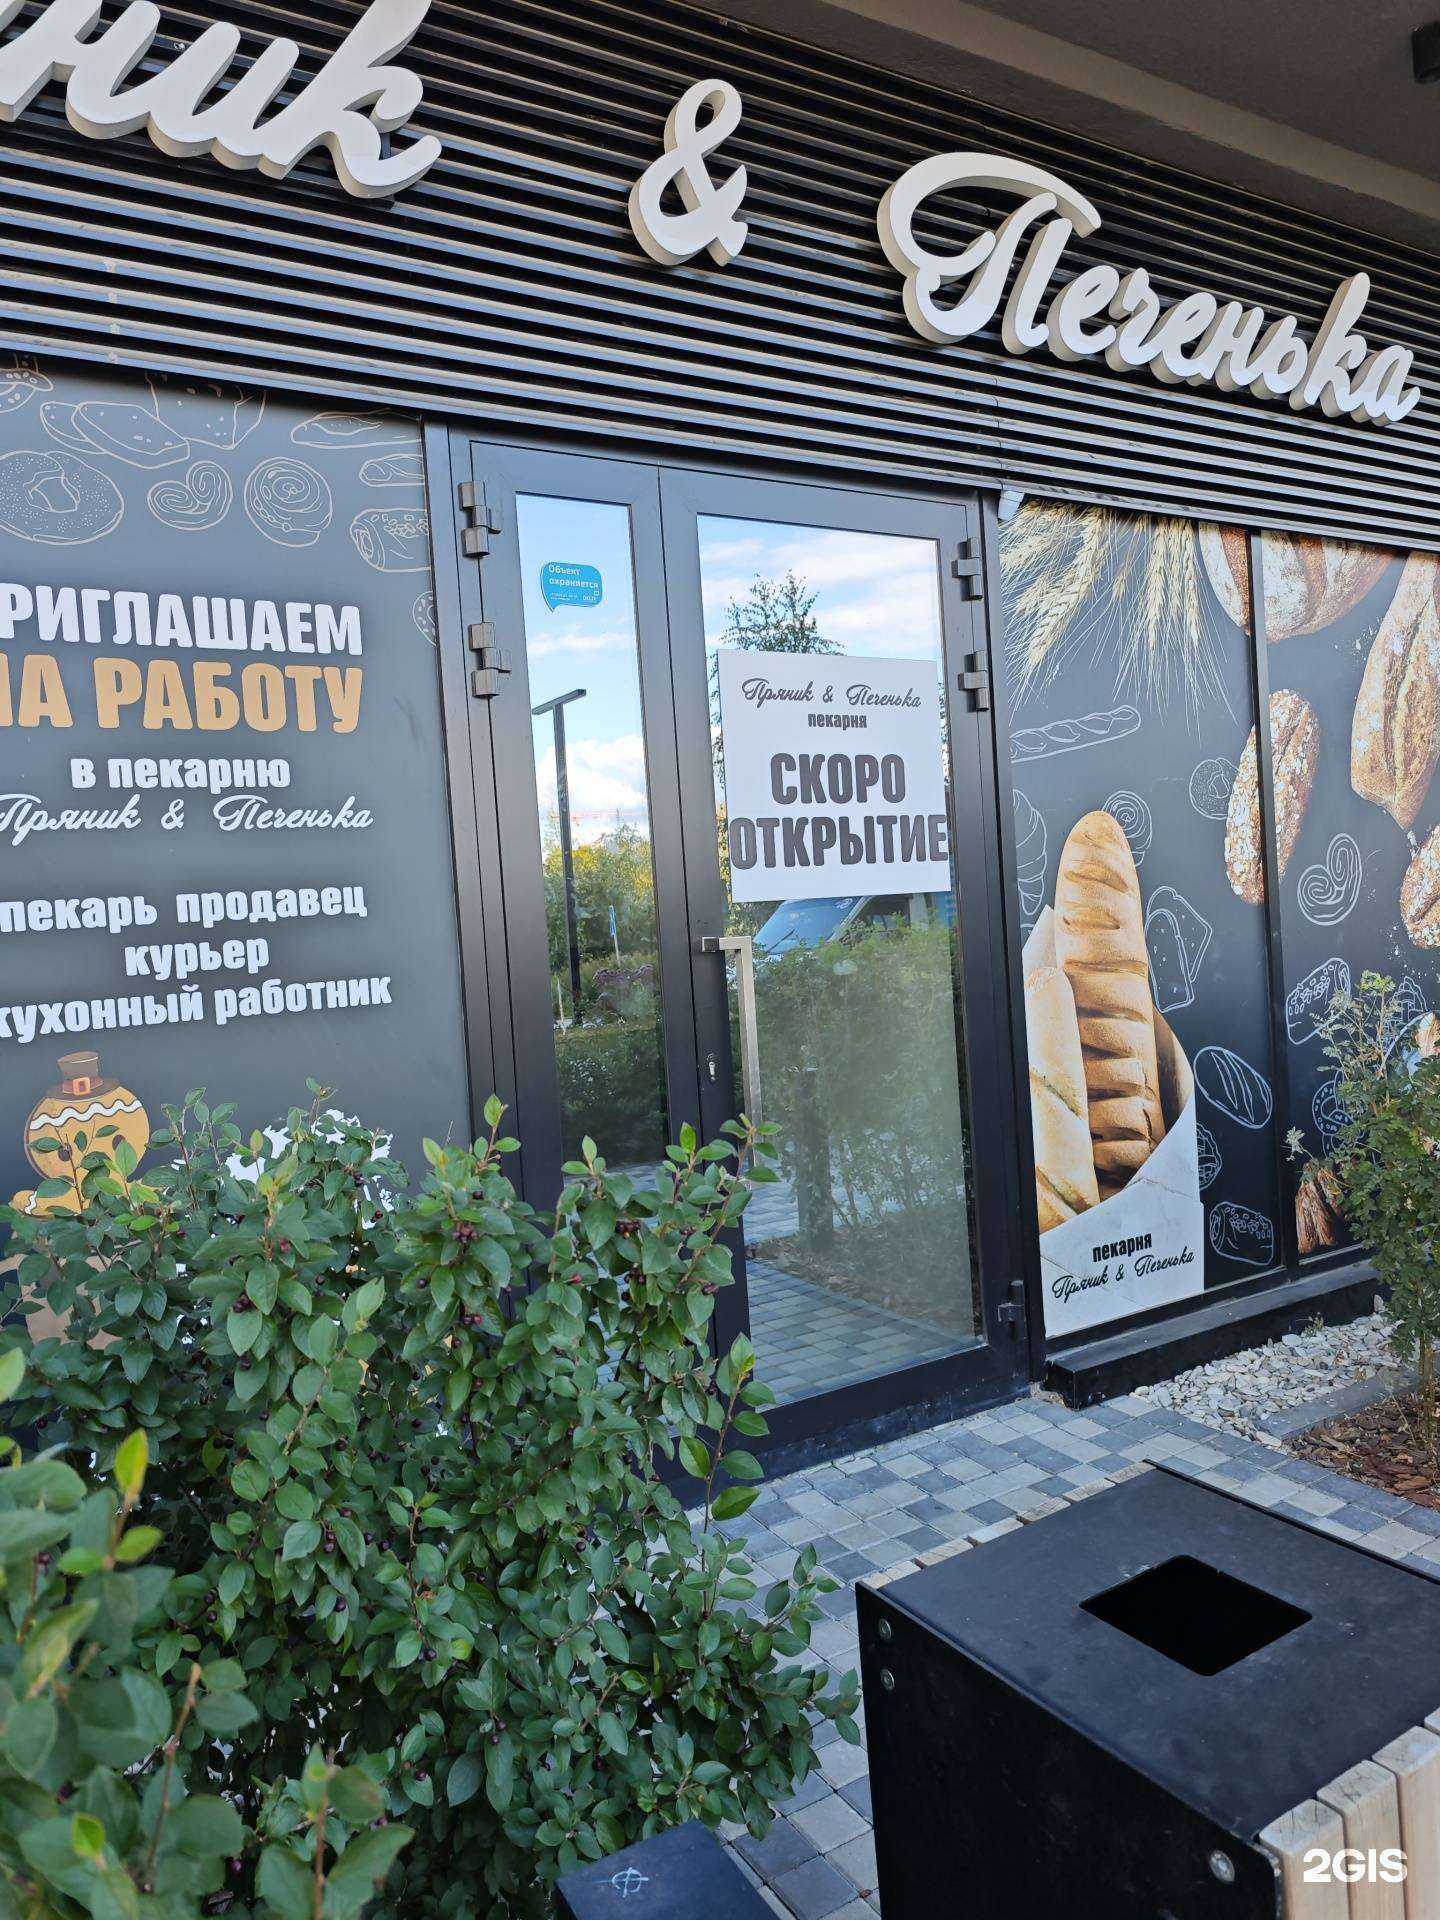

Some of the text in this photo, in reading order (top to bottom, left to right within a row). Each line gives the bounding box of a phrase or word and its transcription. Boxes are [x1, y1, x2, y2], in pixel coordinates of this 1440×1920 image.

[0, 0, 1421, 427] ник & Печенька
[0, 582, 363, 656] РИГЛАШАЕМ
[93, 657, 363, 733] РАБОТУ
[742, 677, 921, 708] Пряник & Печенька
[808, 713, 868, 731] пекарня
[70, 758, 291, 794] в пекарню
[770, 753, 906, 804] СКОРО
[0, 793, 374, 846] Пряник & Печенька
[729, 814, 949, 870] ОТКРЫТИЕ
[0, 886, 367, 934] пекарь продавец
[125, 937, 269, 981] курьер
[214, 976, 392, 1025] работник
[1092, 1233, 1152, 1263] пекарня
[1051, 1246, 1195, 1303] Пряник & Печенька
